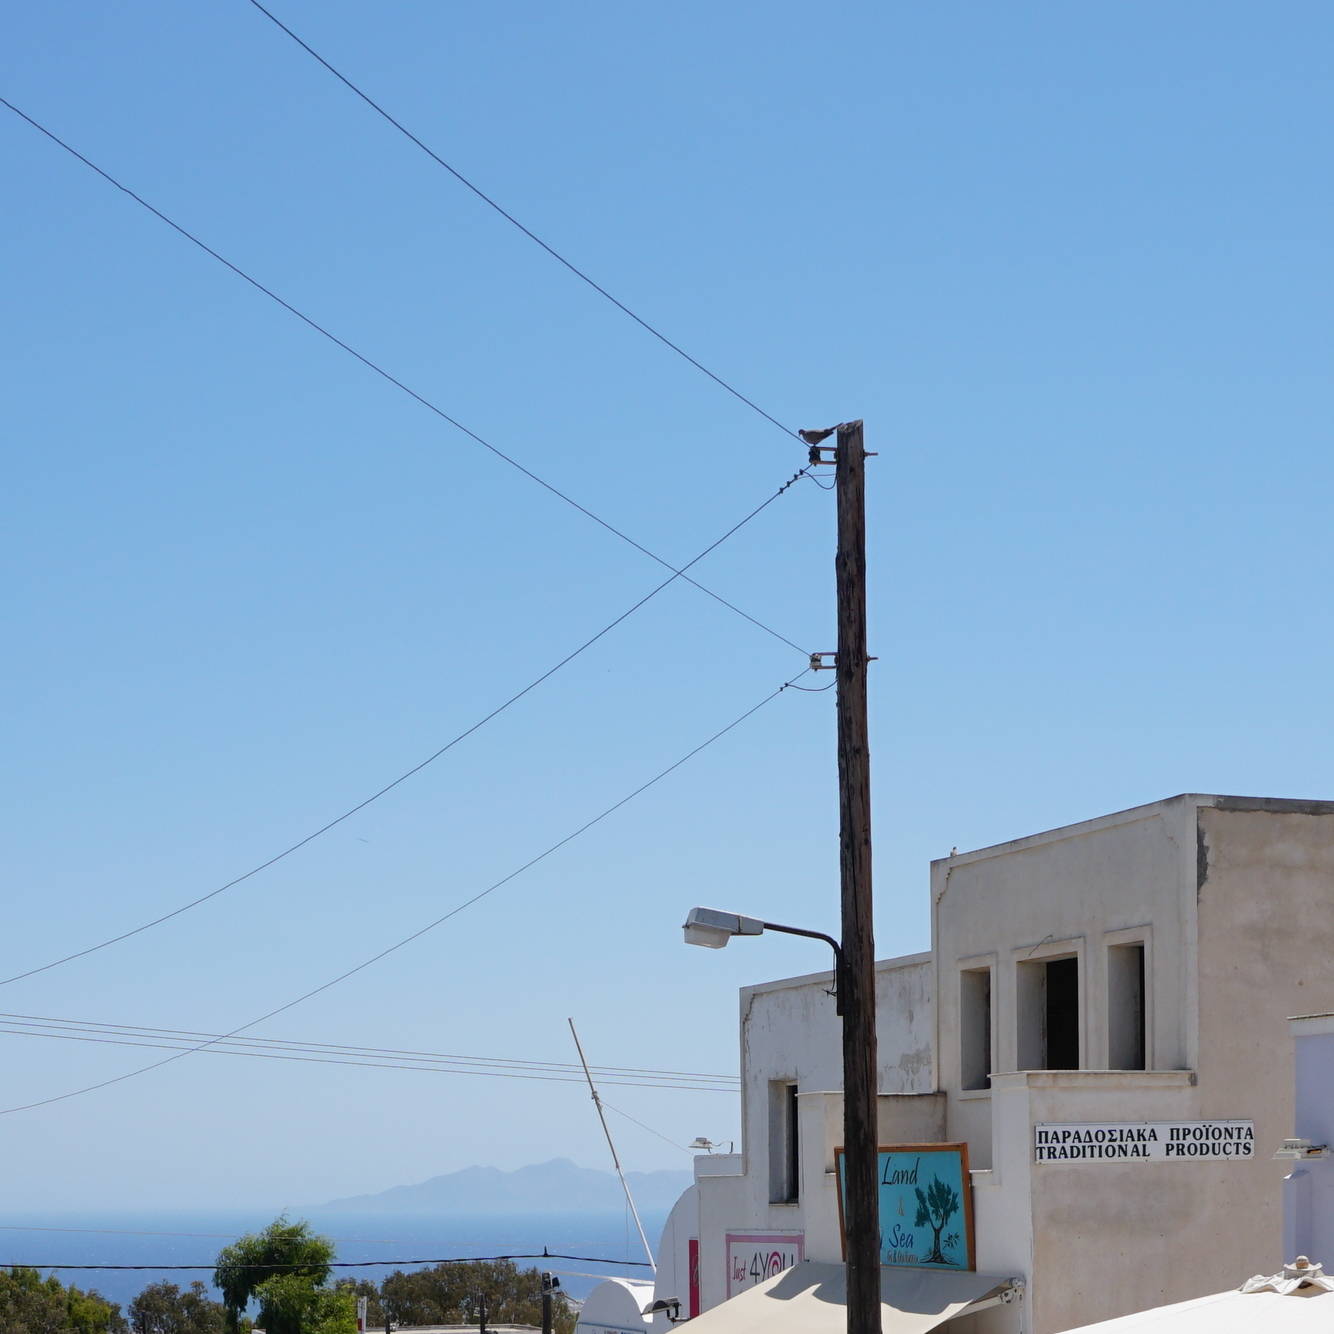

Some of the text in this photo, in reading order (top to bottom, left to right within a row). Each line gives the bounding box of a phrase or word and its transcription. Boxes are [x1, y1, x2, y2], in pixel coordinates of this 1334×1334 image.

[1037, 1125, 1255, 1144] ΠΑΡΑΔΟΣΙΑΚΑ ΠΡΟΪΟΝΤΑ
[1036, 1142, 1252, 1160] TRADITIONAL PRODUCTS
[882, 1156, 920, 1185] Land
[888, 1223, 914, 1248] Sea
[732, 1256, 746, 1282] Just
